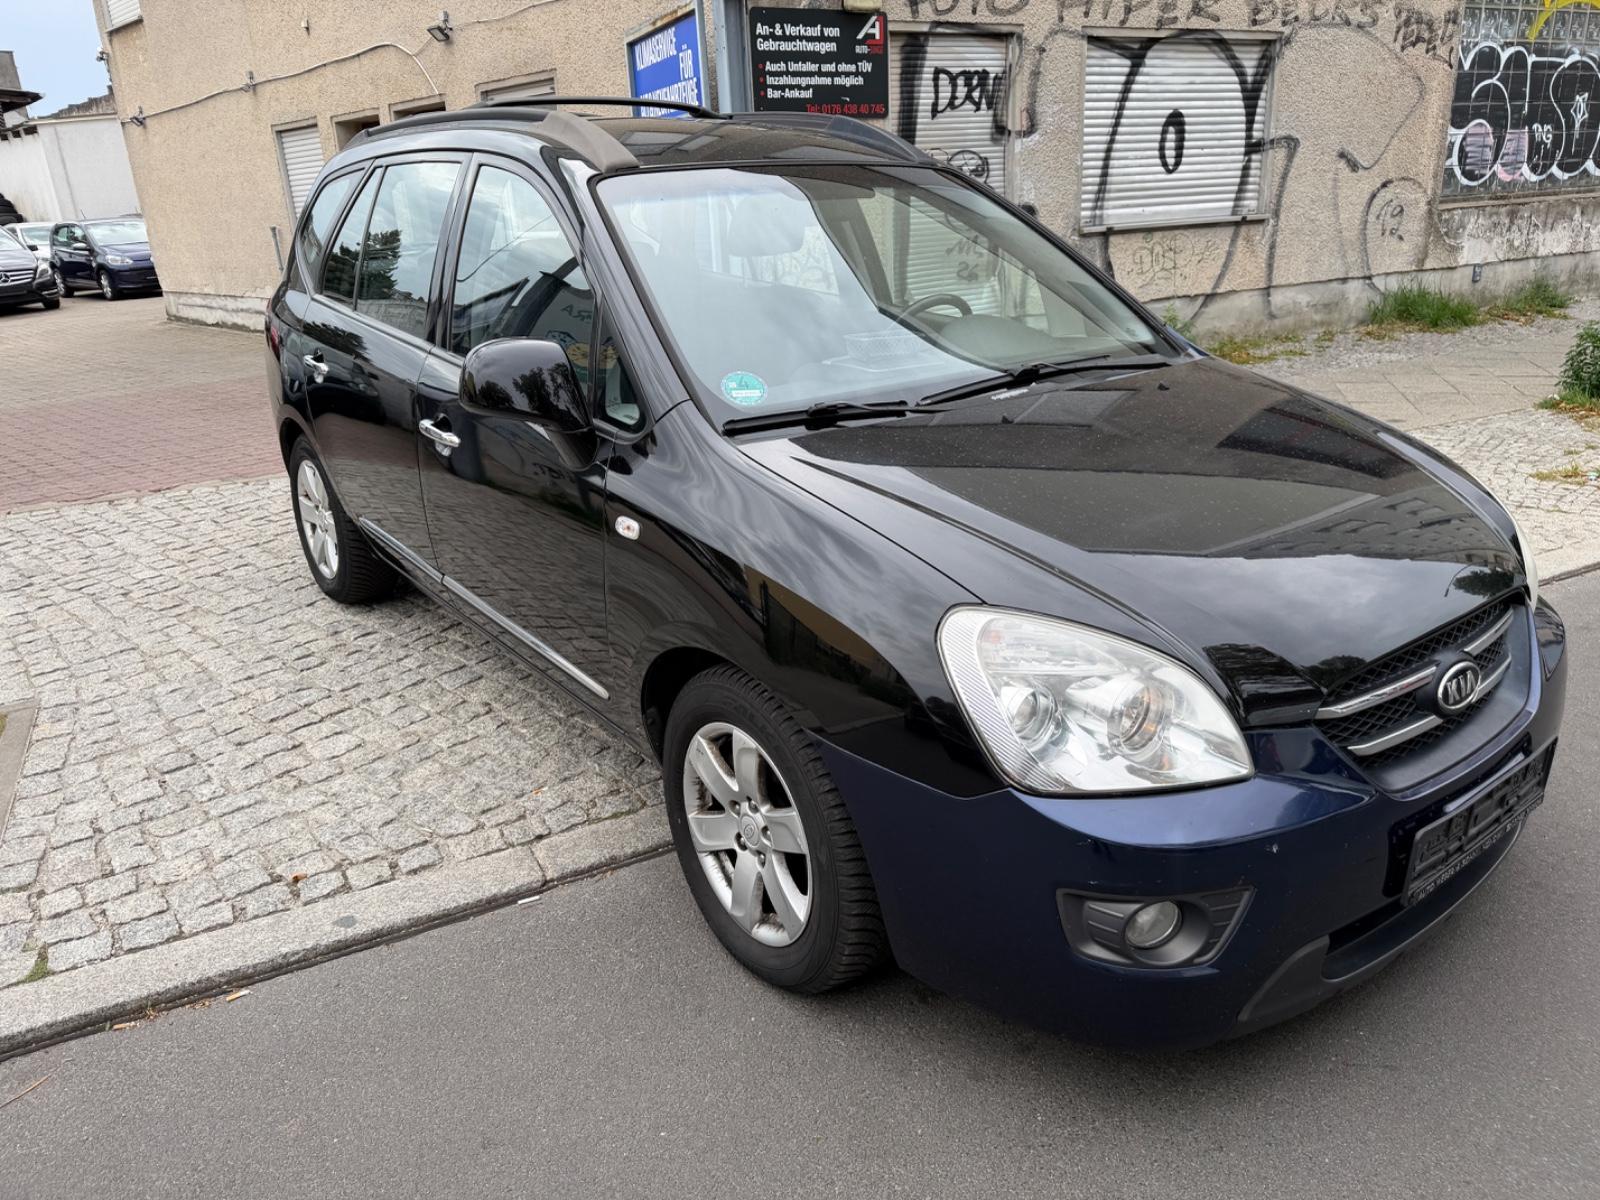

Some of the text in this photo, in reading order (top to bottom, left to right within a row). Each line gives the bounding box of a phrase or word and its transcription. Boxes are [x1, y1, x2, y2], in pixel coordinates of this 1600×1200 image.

[756, 22, 840, 37] An- & Verkauf von
[756, 38, 837, 55] Gebrauchtwagen
[765, 61, 787, 72] Auch
[820, 63, 836, 73] und
[837, 62, 857, 73] ohne
[857, 60, 873, 73] TÜV
[766, 74, 865, 88] Inzahlungnahme möglich
[766, 88, 814, 99] Bar-Ankauf
[1445, 670, 1477, 705] KIA
